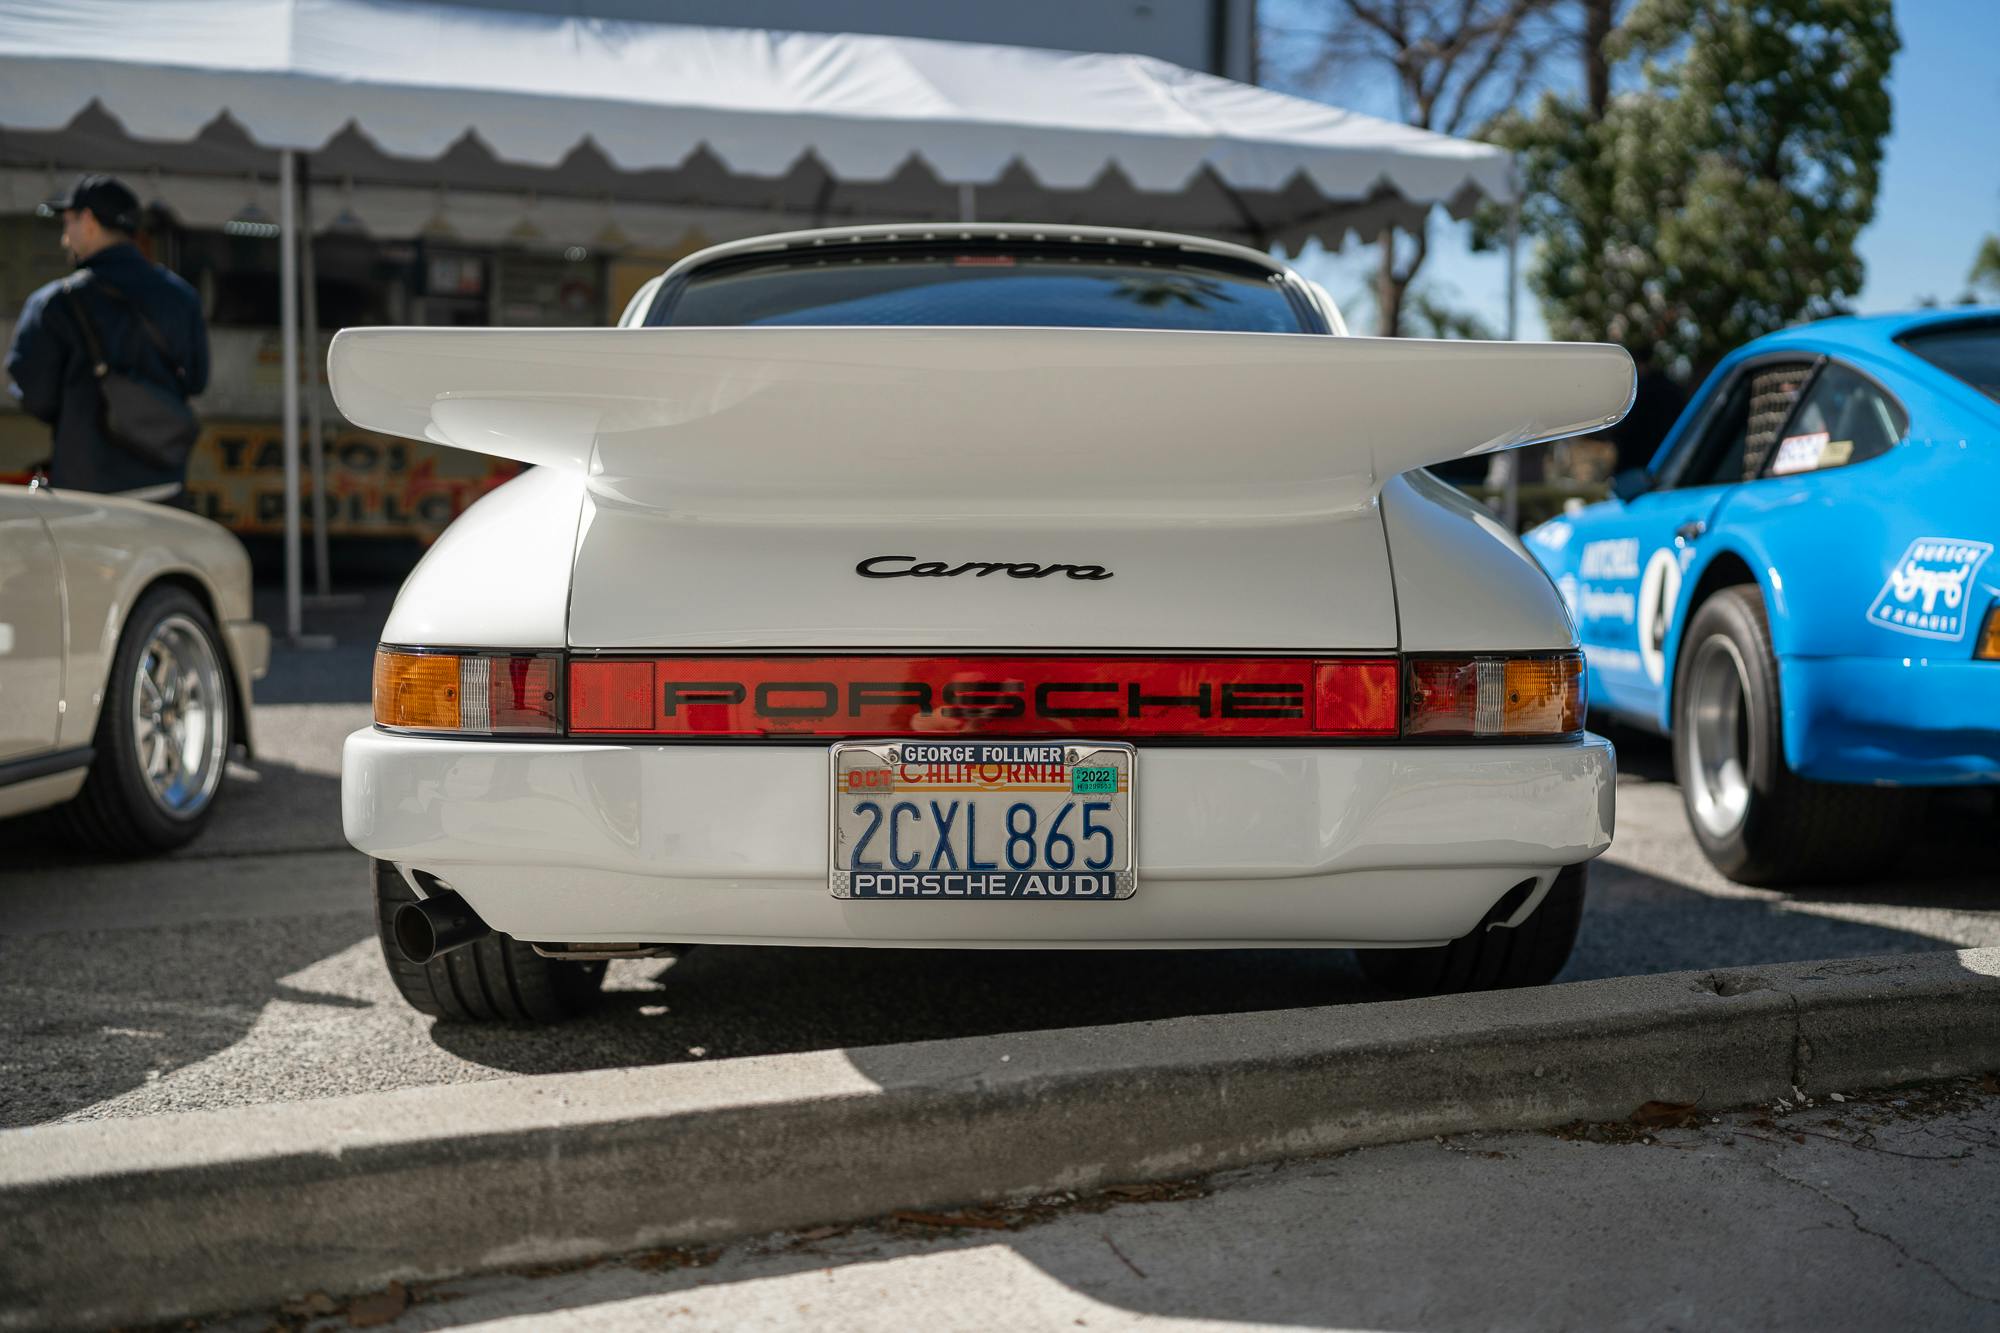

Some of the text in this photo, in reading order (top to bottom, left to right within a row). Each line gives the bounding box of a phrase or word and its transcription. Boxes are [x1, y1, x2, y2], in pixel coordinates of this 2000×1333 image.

[856, 555, 1114, 580] Carrera
[1880, 605, 1958, 632] EXHAUST
[664, 682, 1304, 719] PORSCHE
[905, 747, 1061, 763] GEORGE FOLLMER
[848, 770, 892, 787] OCT
[1081, 770, 1110, 782] 2022
[851, 800, 1114, 871] 2CXL865
[855, 875, 1110, 896] PORSCHE/AUDI
